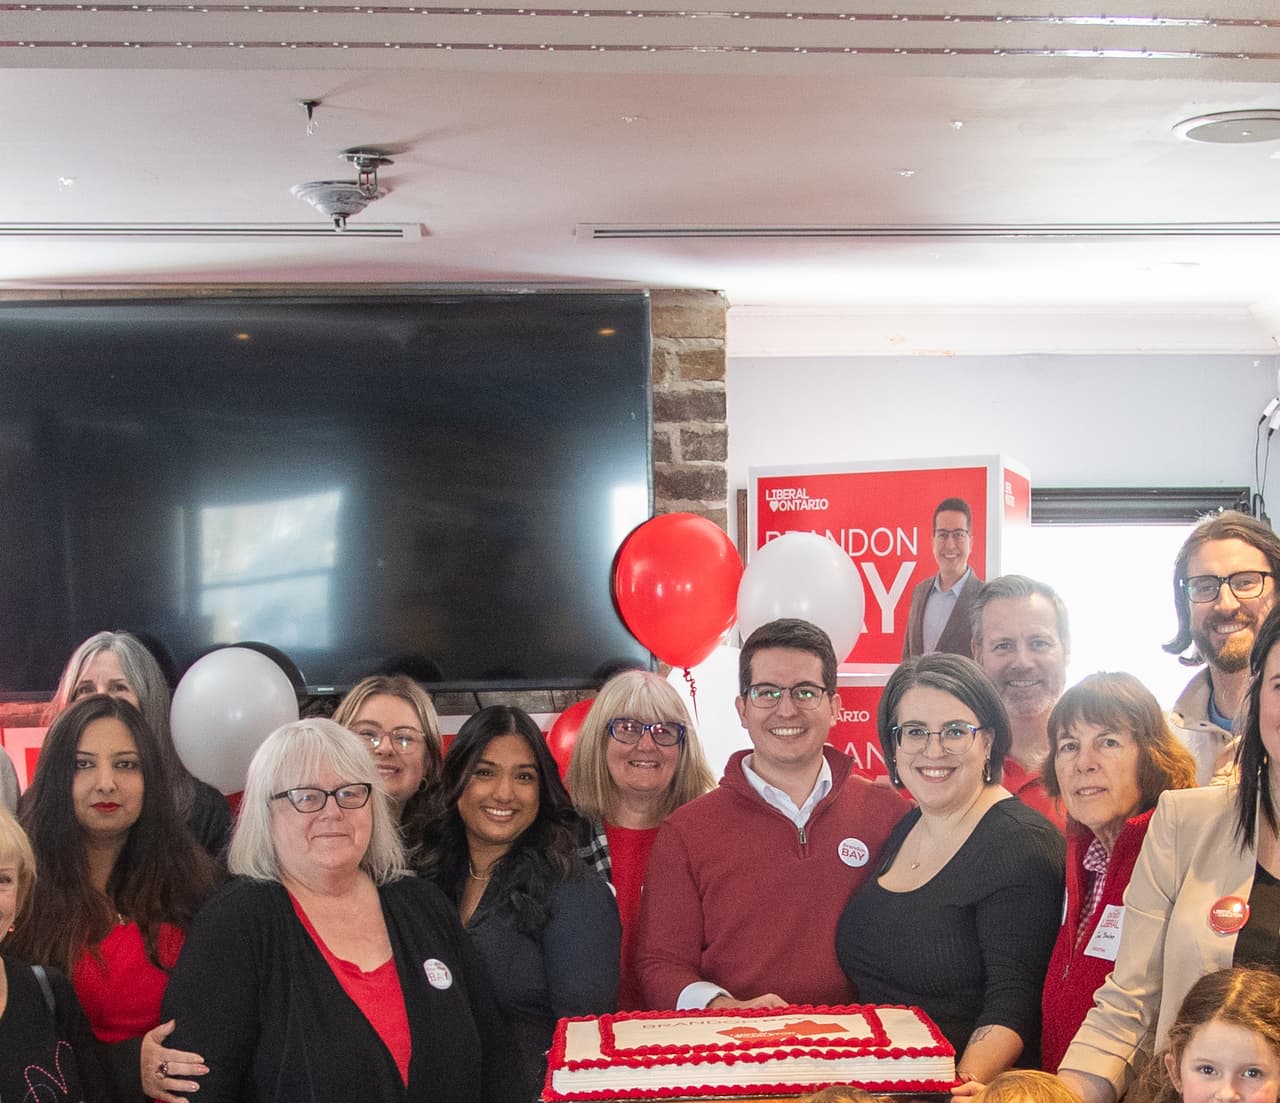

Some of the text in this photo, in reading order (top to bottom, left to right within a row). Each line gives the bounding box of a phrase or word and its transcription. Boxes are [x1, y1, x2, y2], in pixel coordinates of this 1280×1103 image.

[765, 488, 810, 500] LIBERAL
[779, 499, 829, 512] ONTARIO
[766, 527, 918, 556] NDON
[835, 710, 870, 722] ARIO
[841, 848, 865, 861] BAY
